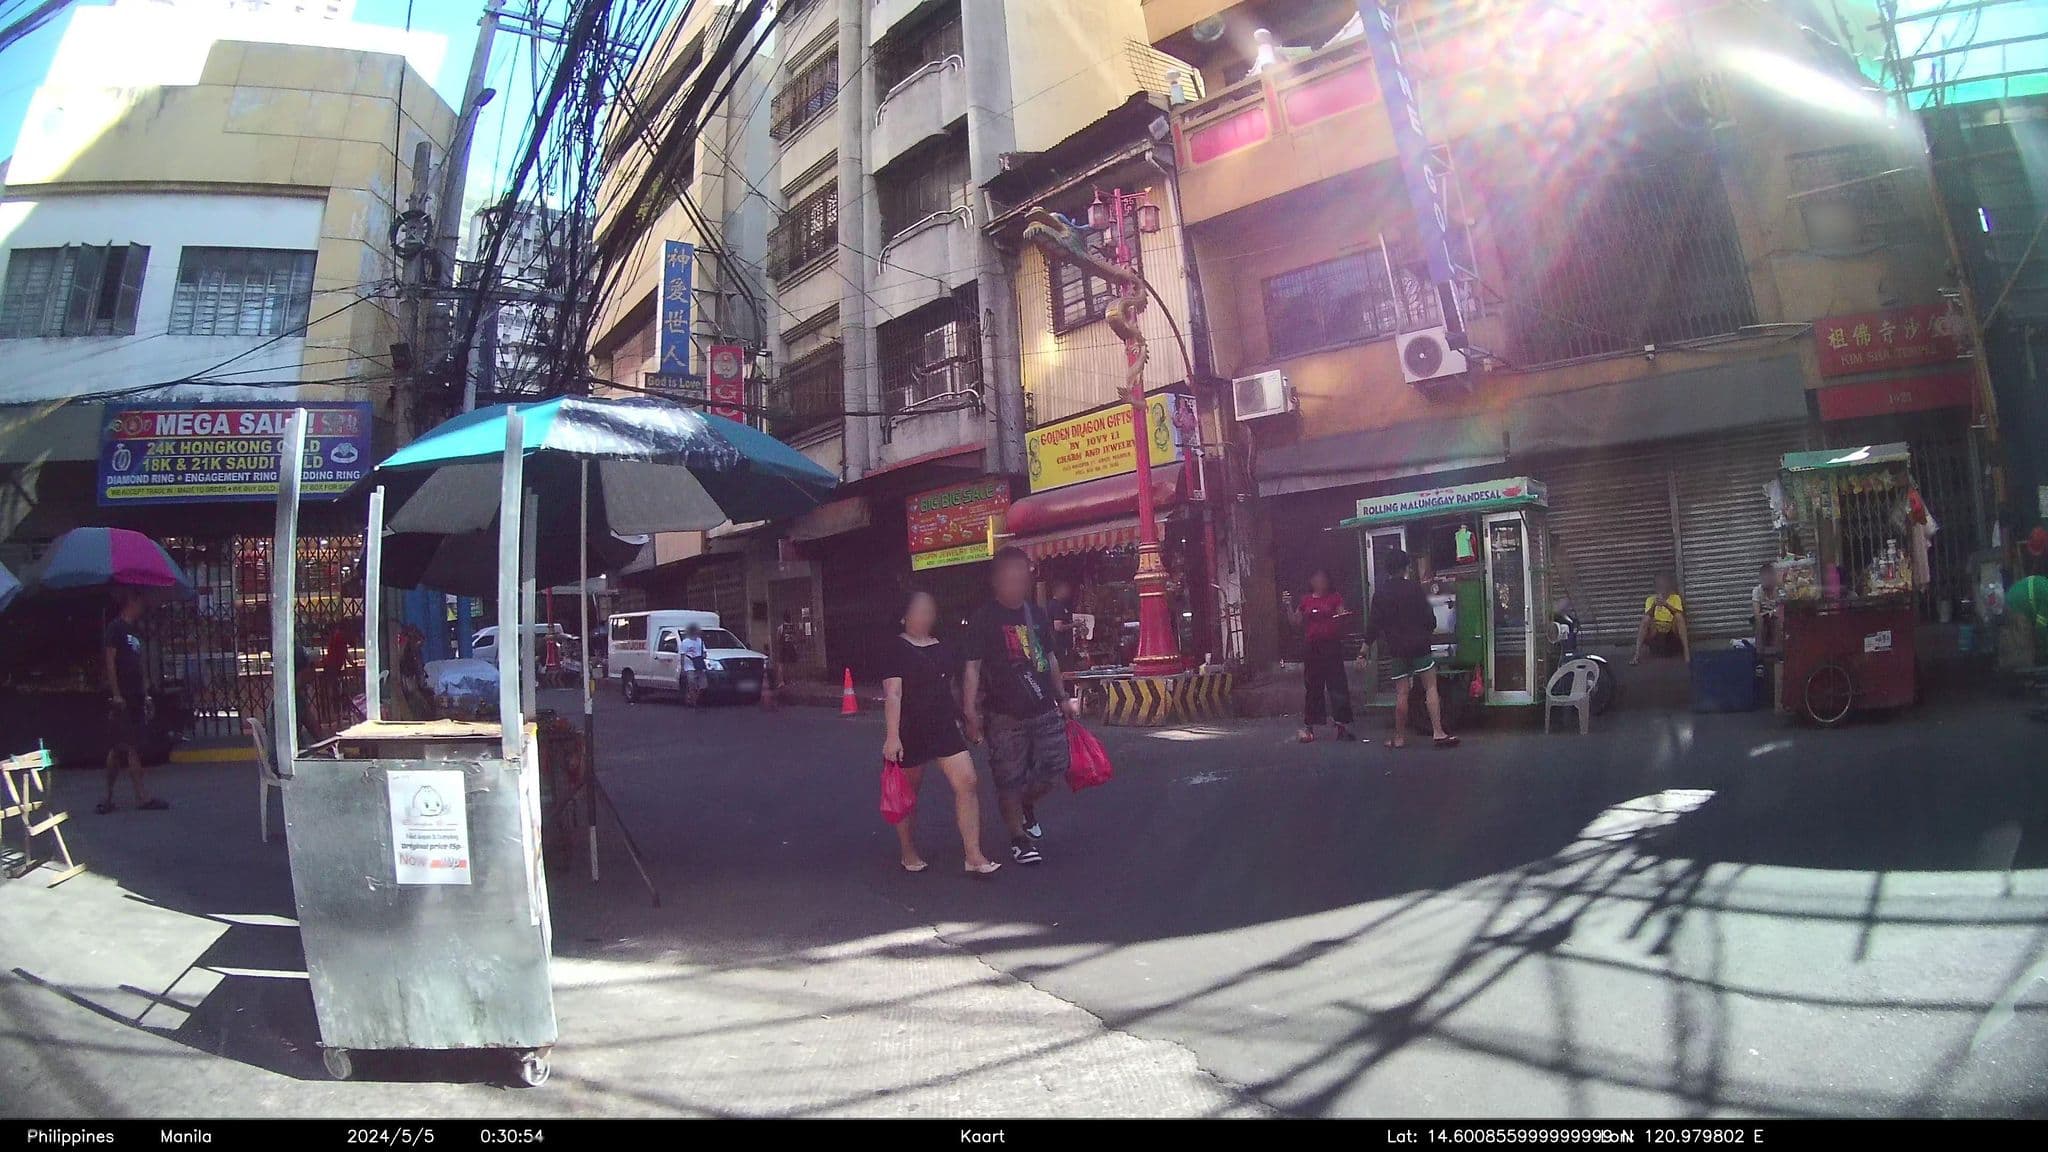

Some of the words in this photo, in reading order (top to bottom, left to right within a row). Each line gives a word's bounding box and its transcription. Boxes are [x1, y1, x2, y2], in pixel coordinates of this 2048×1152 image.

[662, 248, 692, 368] 神愛世人
[647, 375, 667, 388] God
[668, 376, 677, 388] is
[679, 377, 702, 389] Love
[155, 413, 230, 436] MEGA
[239, 412, 315, 434] SAL!
[1040, 425, 1072, 446] GOLDEN
[1071, 414, 1106, 437] DRAGON
[1106, 409, 1132, 429] GIFTS
[146, 441, 176, 455] 24K
[181, 440, 272, 454] HONGKONG
[1069, 440, 1080, 451] BY
[1085, 448, 1101, 458] AND
[142, 457, 171, 472] 18K
[176, 457, 186, 471] &
[191, 456, 221, 471] 21K
[226, 456, 274, 470] SAUDI
[107, 474, 150, 485] DIAMOND
[151, 473, 175, 484] RING
[185, 472, 252, 483] ENGAGEMENT
[253, 471, 277, 481] RING
[336, 470, 360, 480] RING
[257, 484, 276, 492] GOLD
[919, 495, 941, 514] BIG
[941, 491, 962, 509] BIG
[961, 482, 996, 504] SALE
[1362, 501, 1399, 516] ROLLING
[1400, 495, 1455, 512] MALUNGGAY
[1456, 489, 1501, 505] PANDESAL
